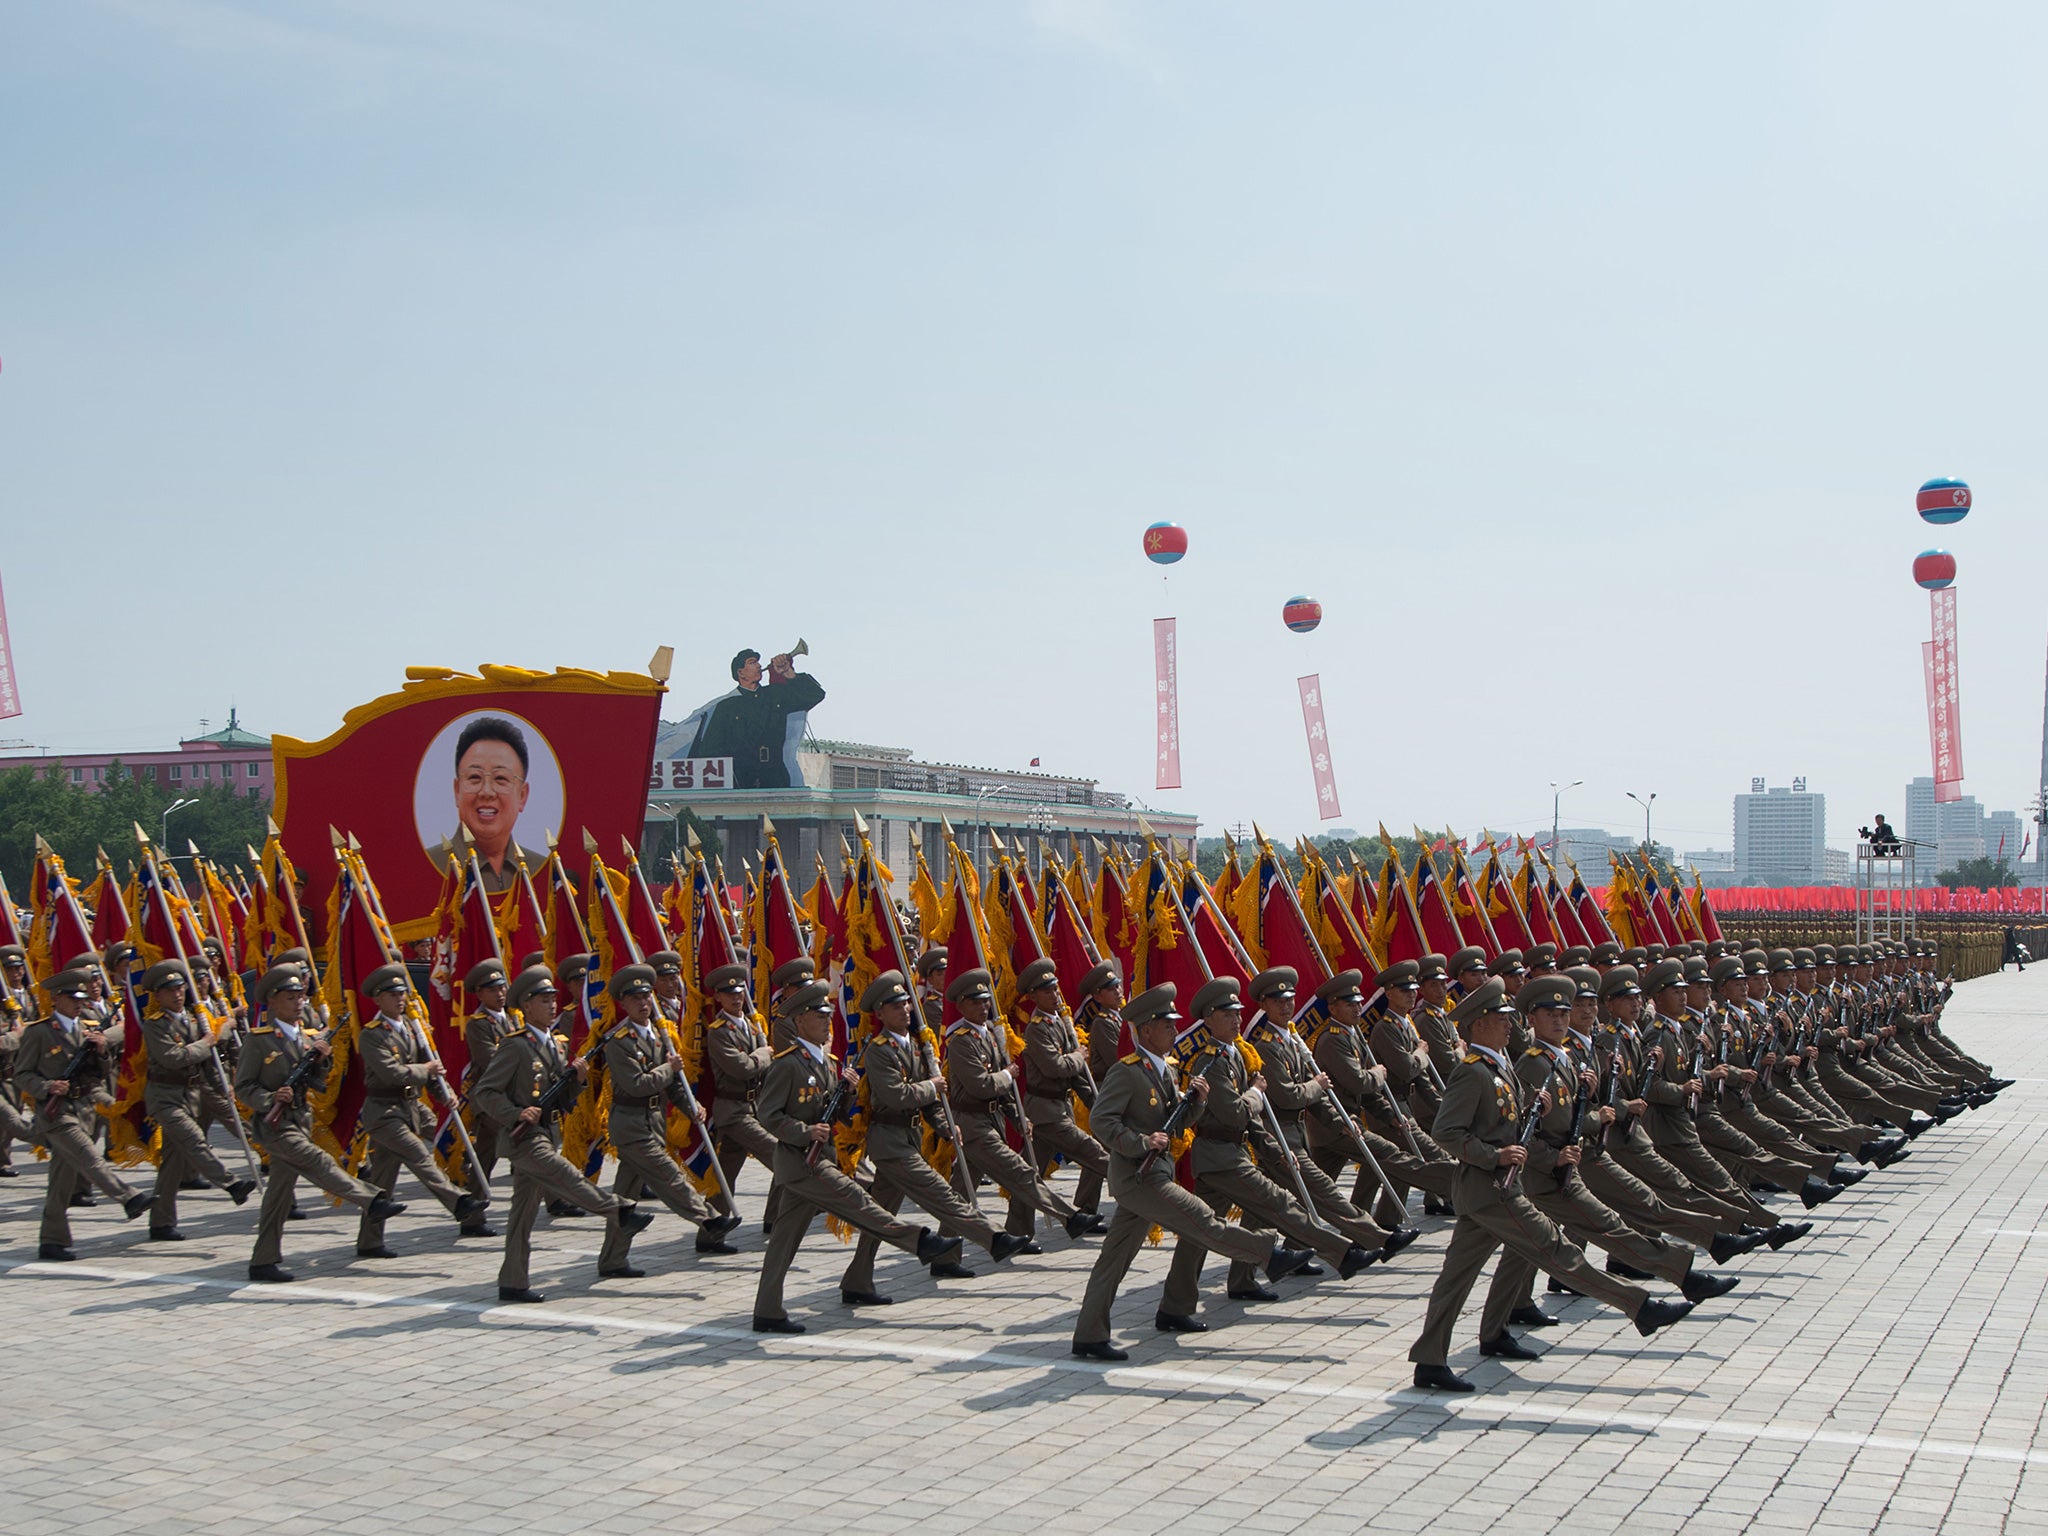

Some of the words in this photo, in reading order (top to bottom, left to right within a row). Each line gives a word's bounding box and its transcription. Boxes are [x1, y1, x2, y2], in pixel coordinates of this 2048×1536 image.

[1944, 595, 1954, 623] 우리
[1937, 681, 1948, 723] 영광이
[1938, 727, 1950, 781] 있으라!
